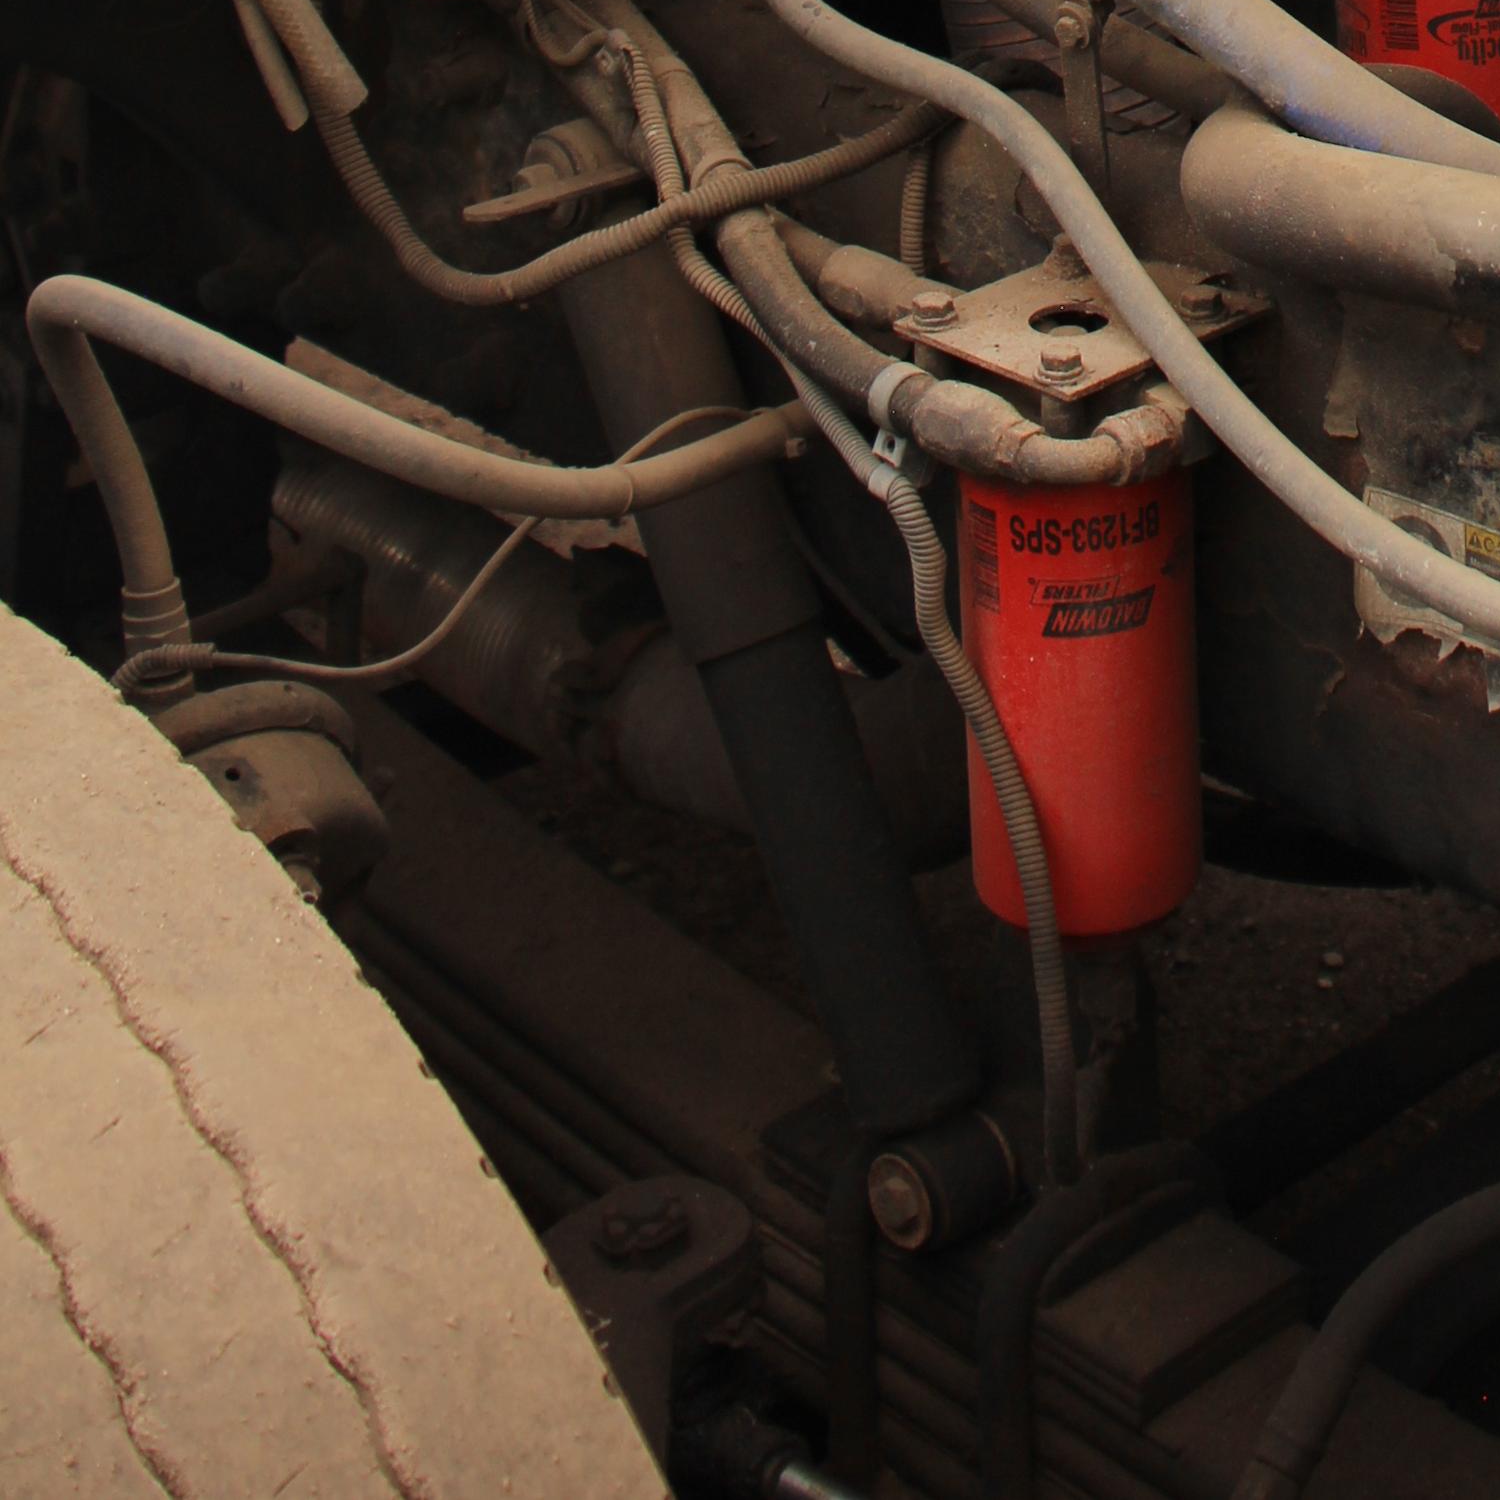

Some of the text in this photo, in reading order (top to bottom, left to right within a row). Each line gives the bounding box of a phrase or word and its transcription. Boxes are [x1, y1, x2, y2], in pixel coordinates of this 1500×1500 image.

[1009, 501, 1161, 555] BF1293-SPS
[1042, 583, 1110, 601] FILTERS
[1051, 598, 1147, 633] BALDWIN
